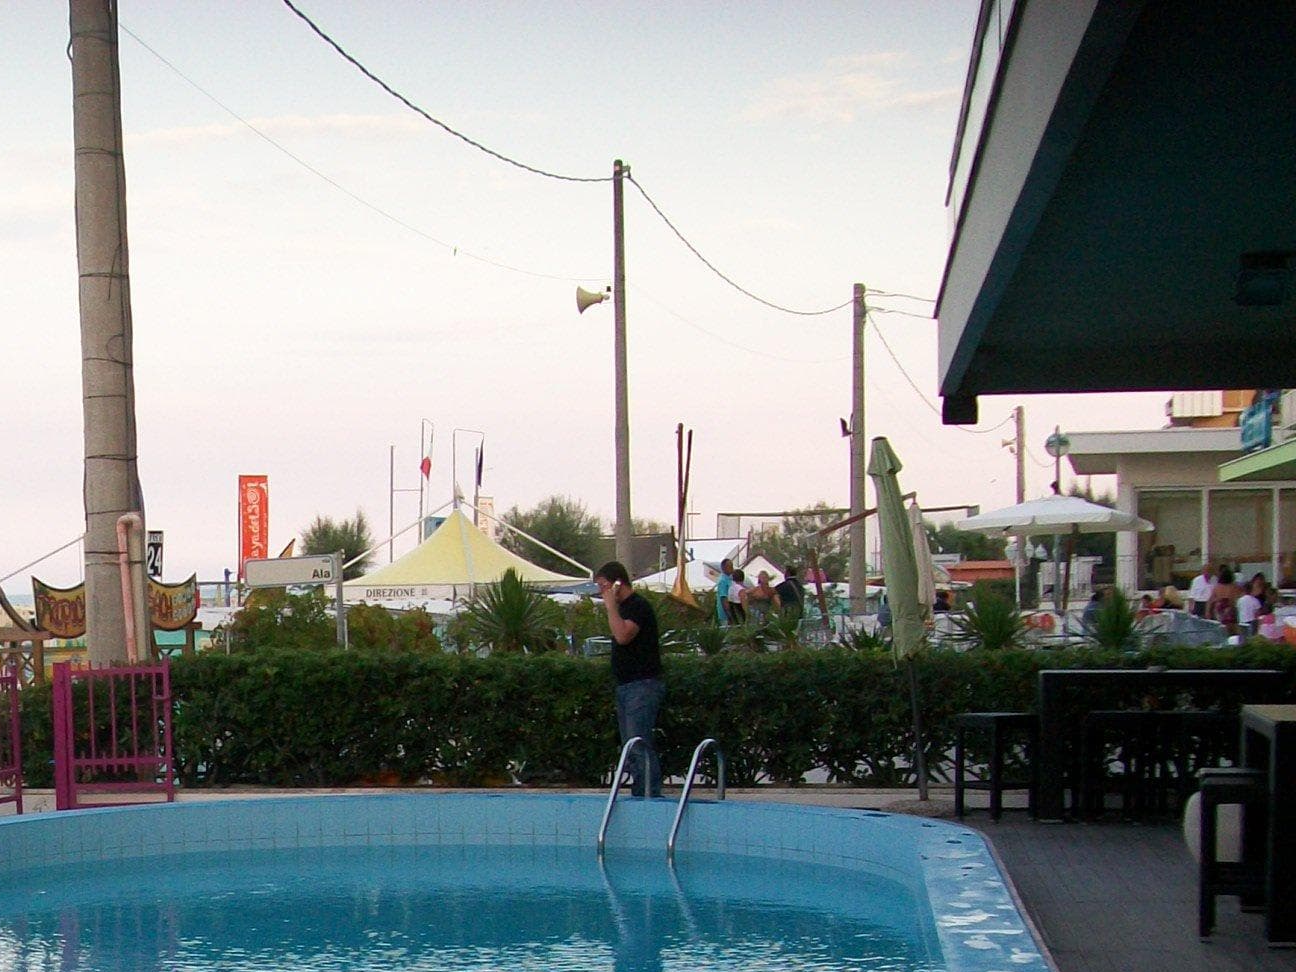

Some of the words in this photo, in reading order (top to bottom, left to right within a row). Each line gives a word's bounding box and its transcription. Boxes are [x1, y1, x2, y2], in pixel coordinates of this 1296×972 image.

[147, 546, 162, 575] 24
[312, 569, 331, 579] Ala
[366, 588, 416, 598] DIREZIONE
